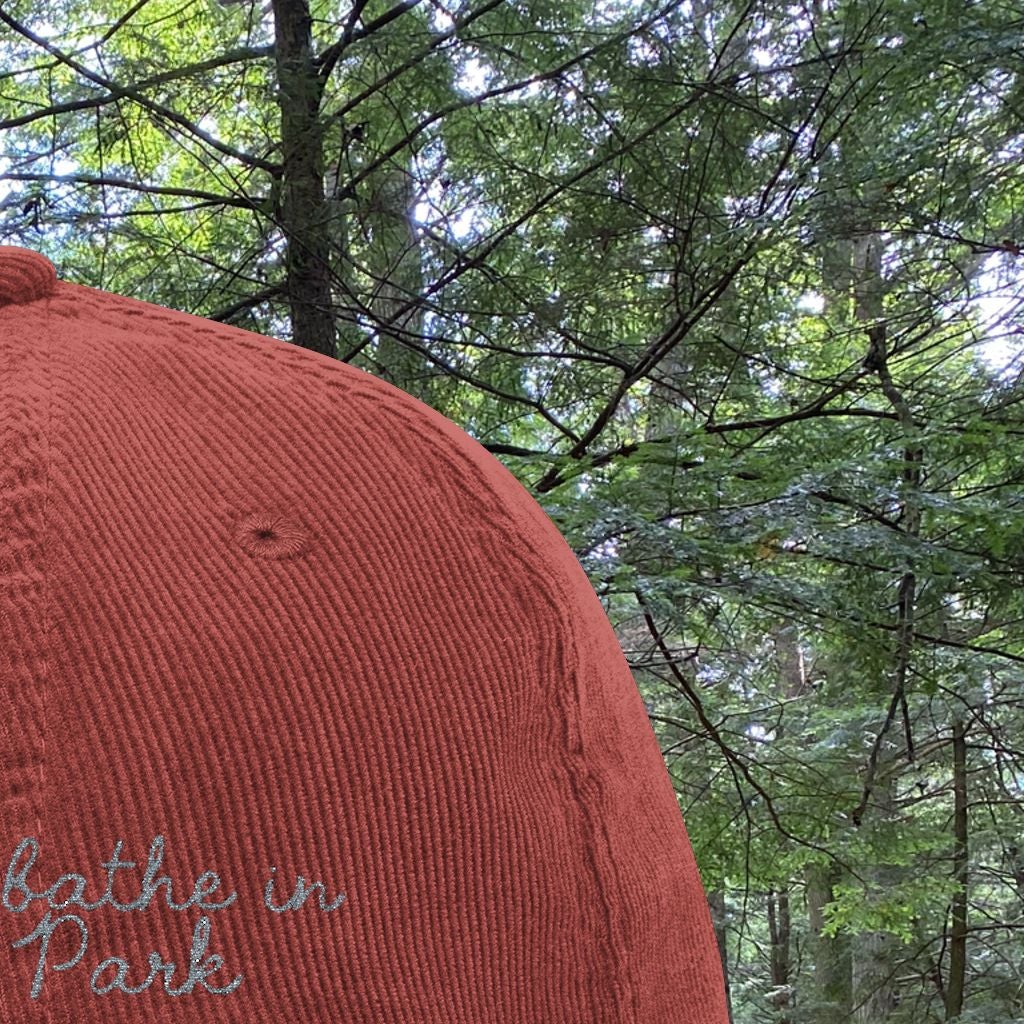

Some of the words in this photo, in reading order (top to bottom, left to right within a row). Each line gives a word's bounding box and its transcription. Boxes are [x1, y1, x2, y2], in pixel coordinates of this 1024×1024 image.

[2, 836, 237, 912] bathe
[264, 866, 344, 912] in
[13, 913, 242, 998] Park
